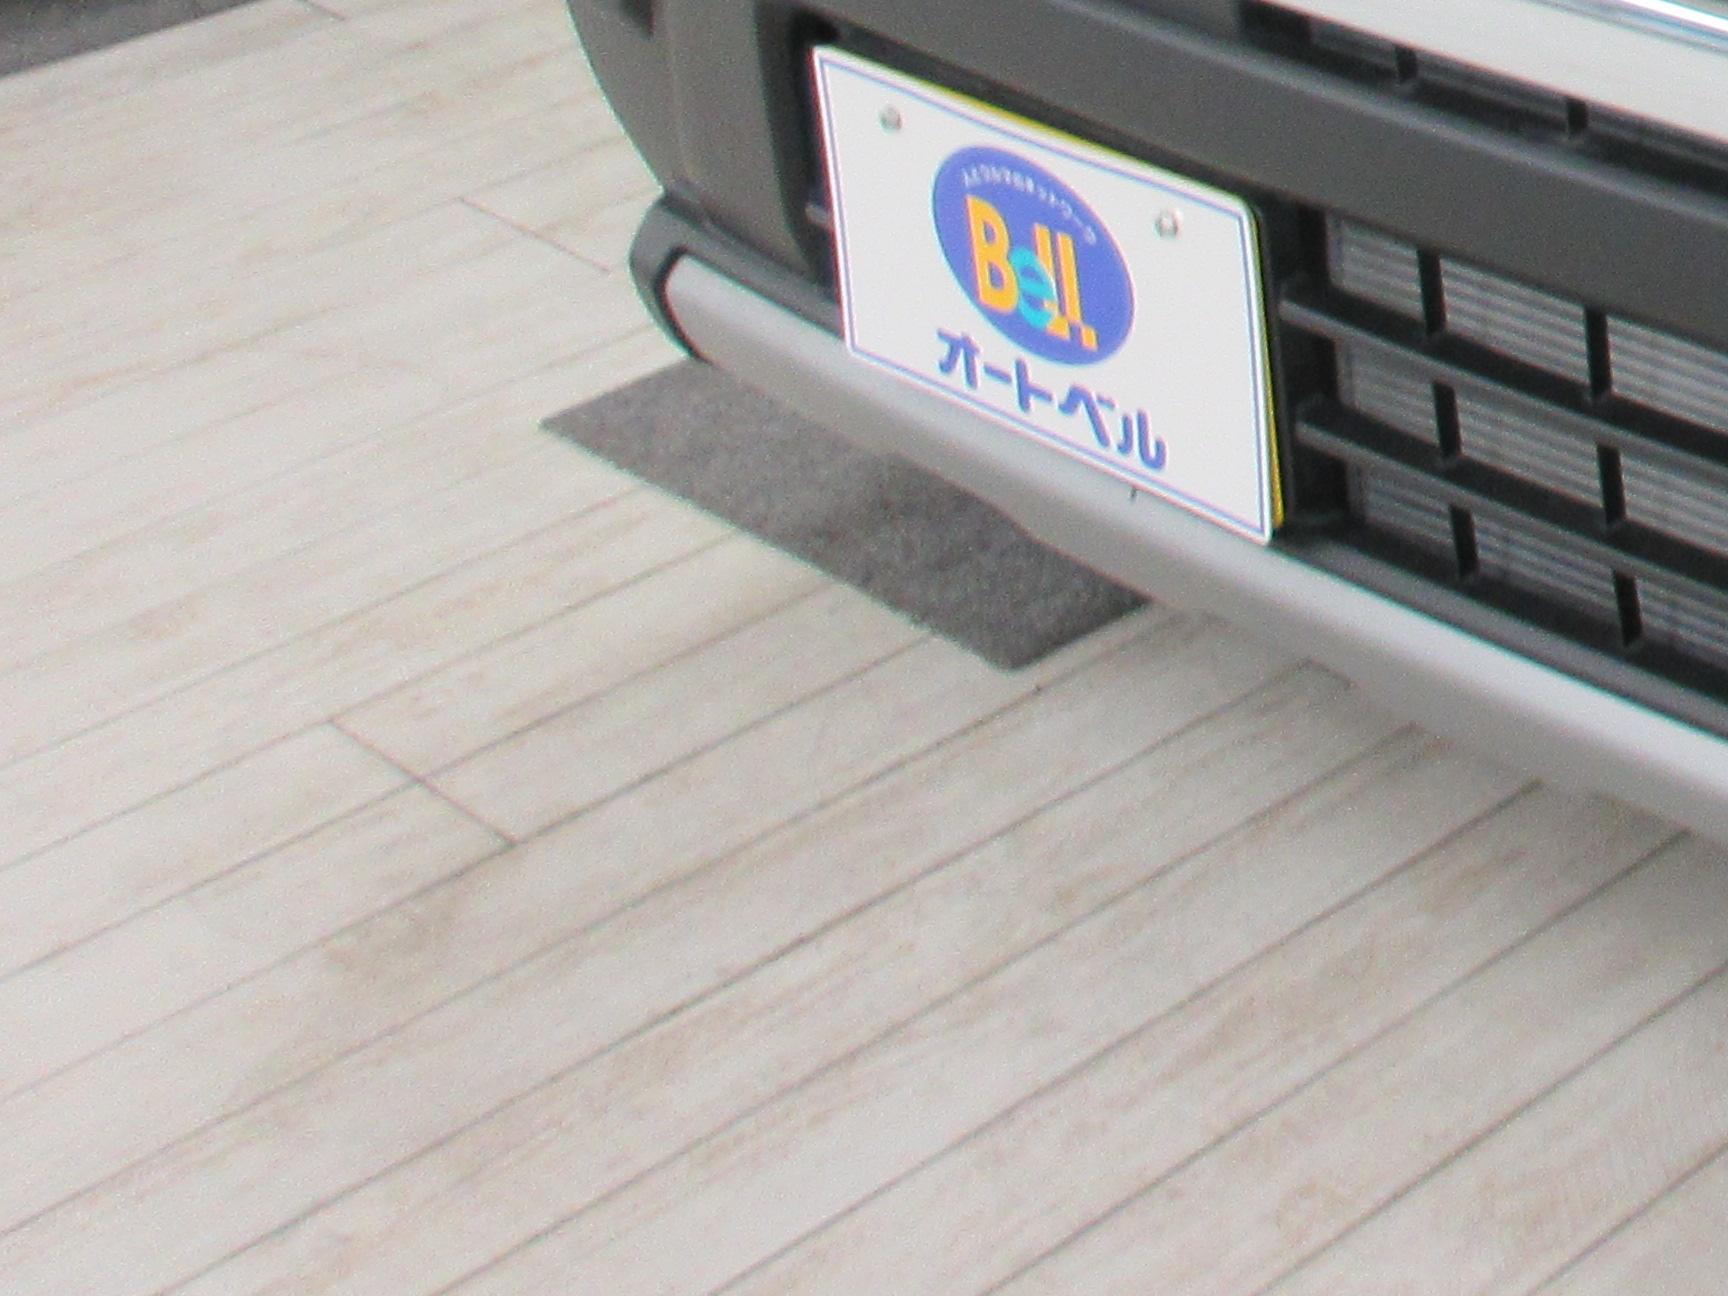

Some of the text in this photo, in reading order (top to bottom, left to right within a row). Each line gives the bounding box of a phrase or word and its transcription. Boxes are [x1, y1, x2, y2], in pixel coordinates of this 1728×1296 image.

[936, 328, 1169, 472] オートベル
